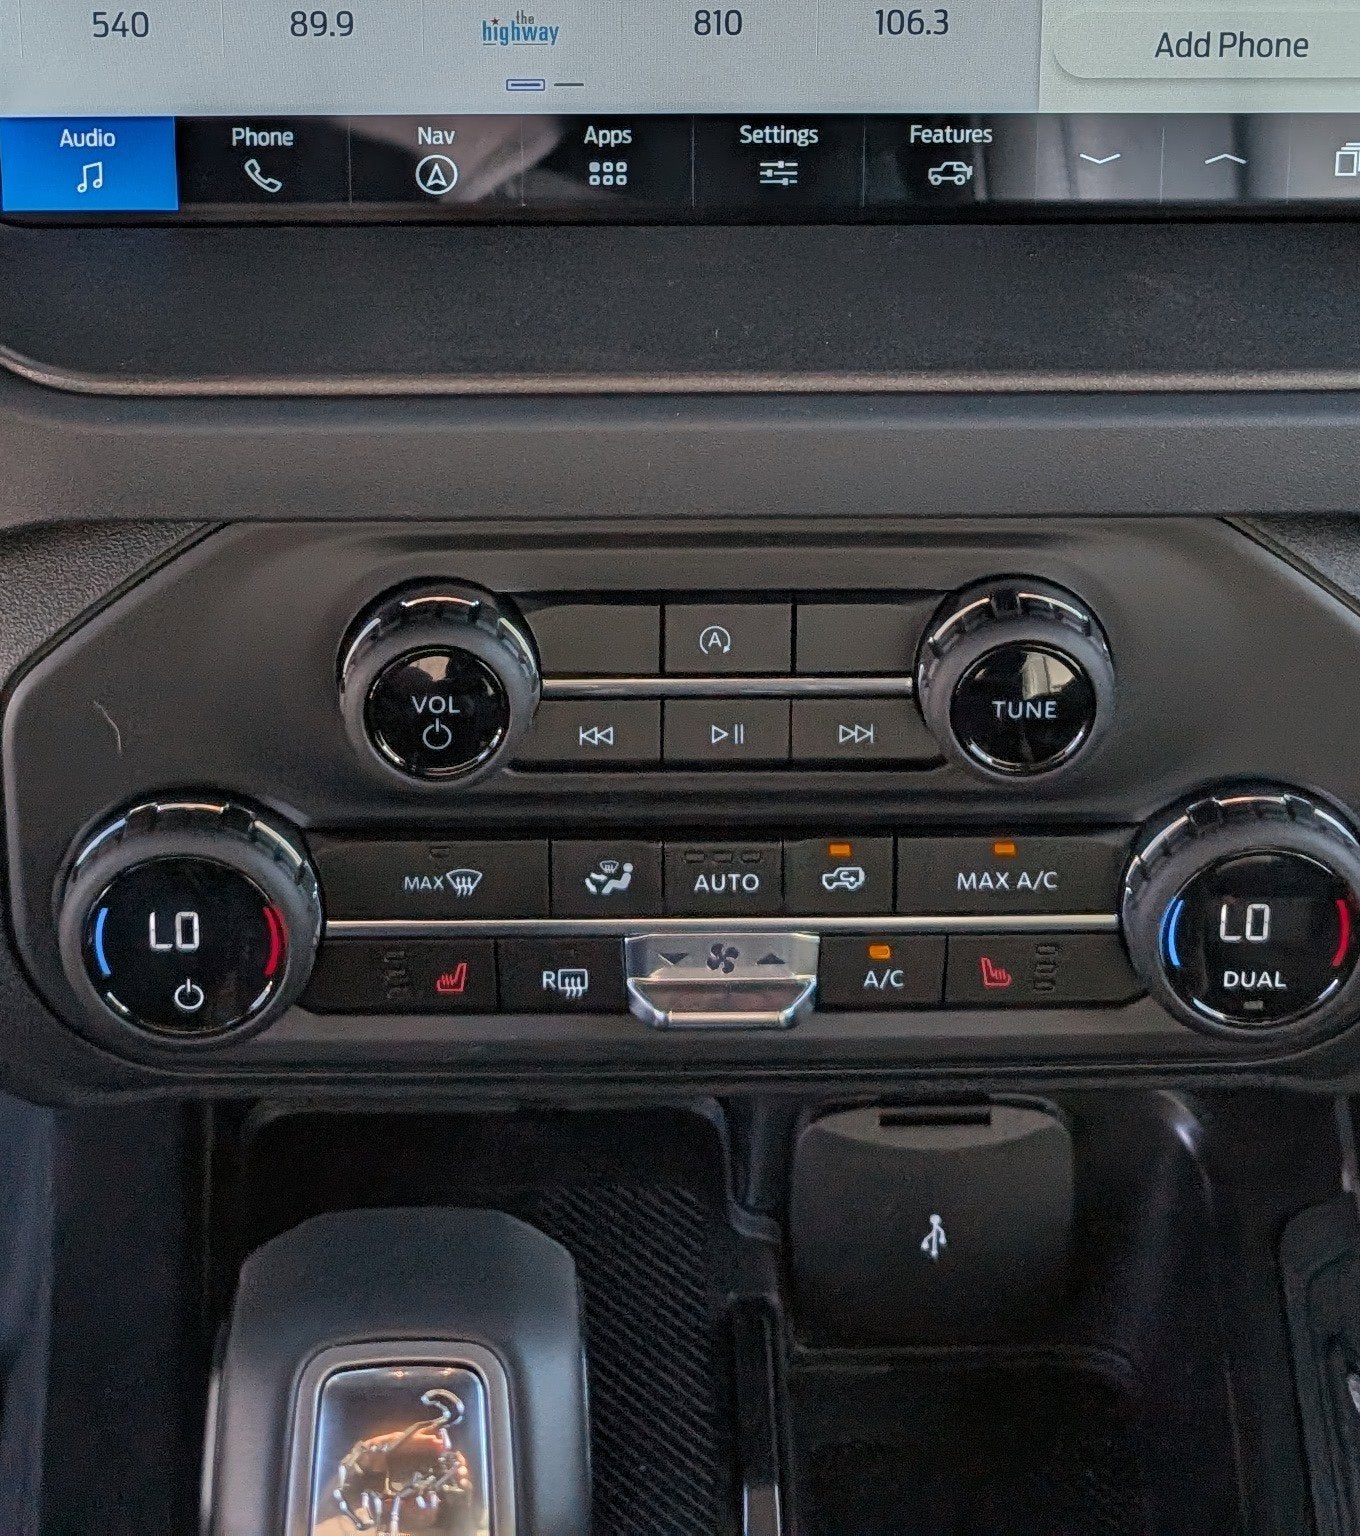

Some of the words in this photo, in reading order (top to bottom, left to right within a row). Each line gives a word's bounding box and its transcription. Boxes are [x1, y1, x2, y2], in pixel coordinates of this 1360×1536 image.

[92, 11, 149, 38] 540
[290, 11, 354, 38] 89.9
[516, 10, 534, 24] the
[693, 9, 742, 37] 810
[875, 9, 949, 36] 106.3
[483, 20, 559, 46] highway
[1155, 31, 1210, 58] Add
[1219, 31, 1309, 58] Phone
[59, 128, 116, 148] Audio
[232, 126, 294, 148] Phone
[418, 126, 456, 145] Nav
[584, 125, 632, 147] Apps
[740, 124, 818, 146] Settings
[909, 124, 993, 145] Features
[412, 696, 460, 714] VOL
[992, 700, 1058, 720] TUNE
[404, 876, 443, 891] MAX
[694, 873, 759, 893] AUTO
[957, 870, 1008, 890] MAX
[1015, 869, 1058, 892] A/C
[149, 912, 199, 950] LO
[1219, 903, 1271, 942] LO
[864, 969, 904, 990] A/C
[1223, 971, 1286, 990] DUAL
